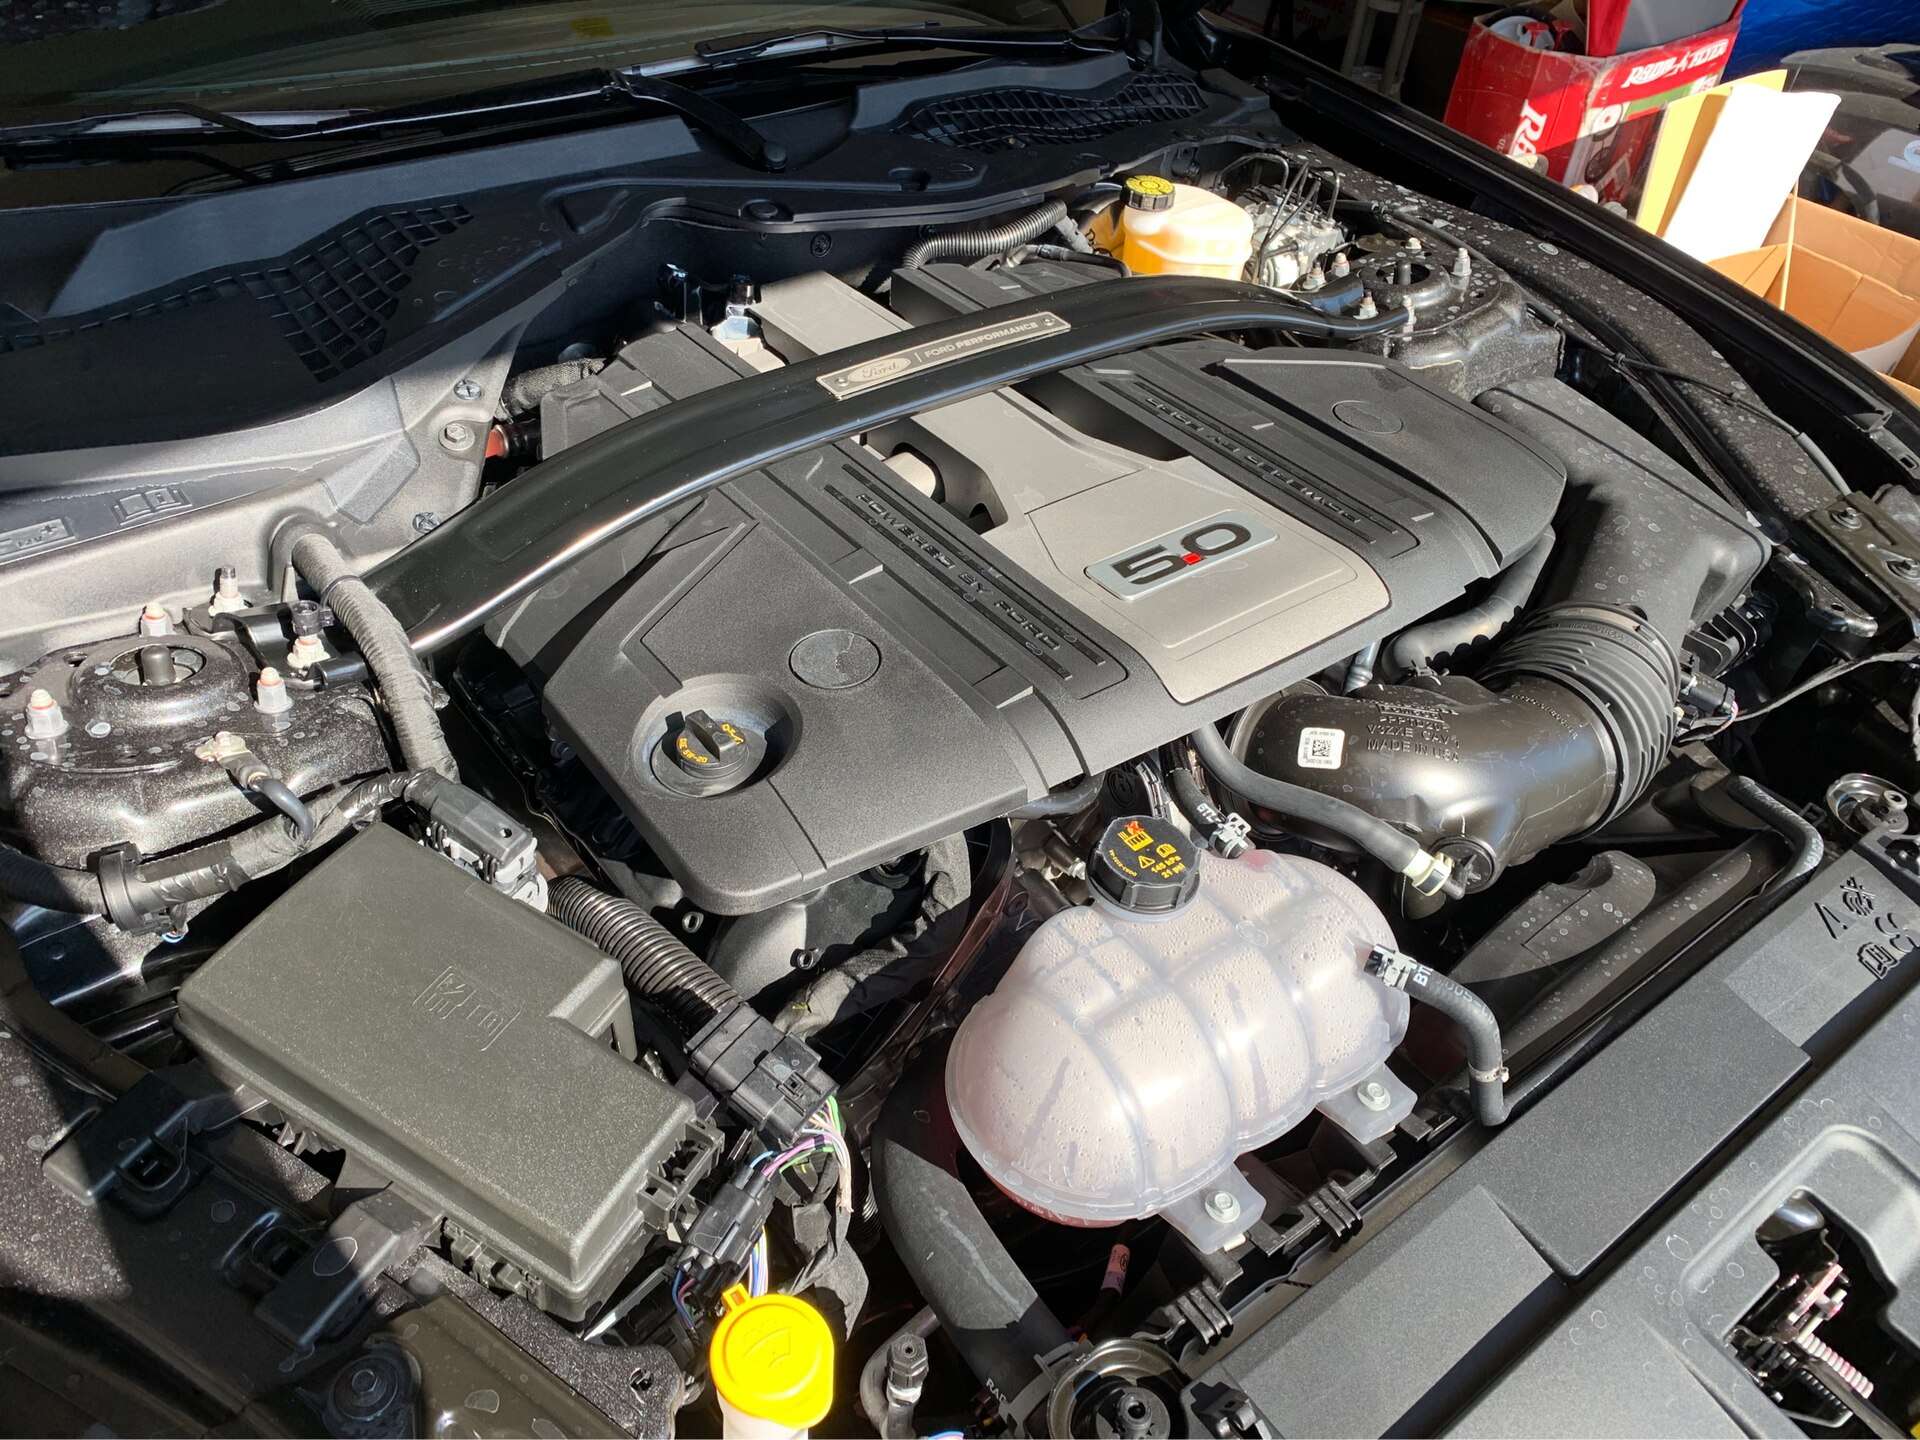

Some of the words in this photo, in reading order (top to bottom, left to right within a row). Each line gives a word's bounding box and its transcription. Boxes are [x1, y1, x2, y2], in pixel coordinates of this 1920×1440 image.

[924, 344, 956, 359] FORD
[956, 322, 1039, 350] PERFORMANCE
[856, 494, 955, 569] POWERED
[958, 572, 994, 595] BY
[994, 600, 1061, 650] FORD
[1111, 522, 1252, 585] 5.0
[1367, 738, 1411, 753] MADE
[1415, 742, 1428, 757] IN
[1432, 746, 1460, 763] USA
